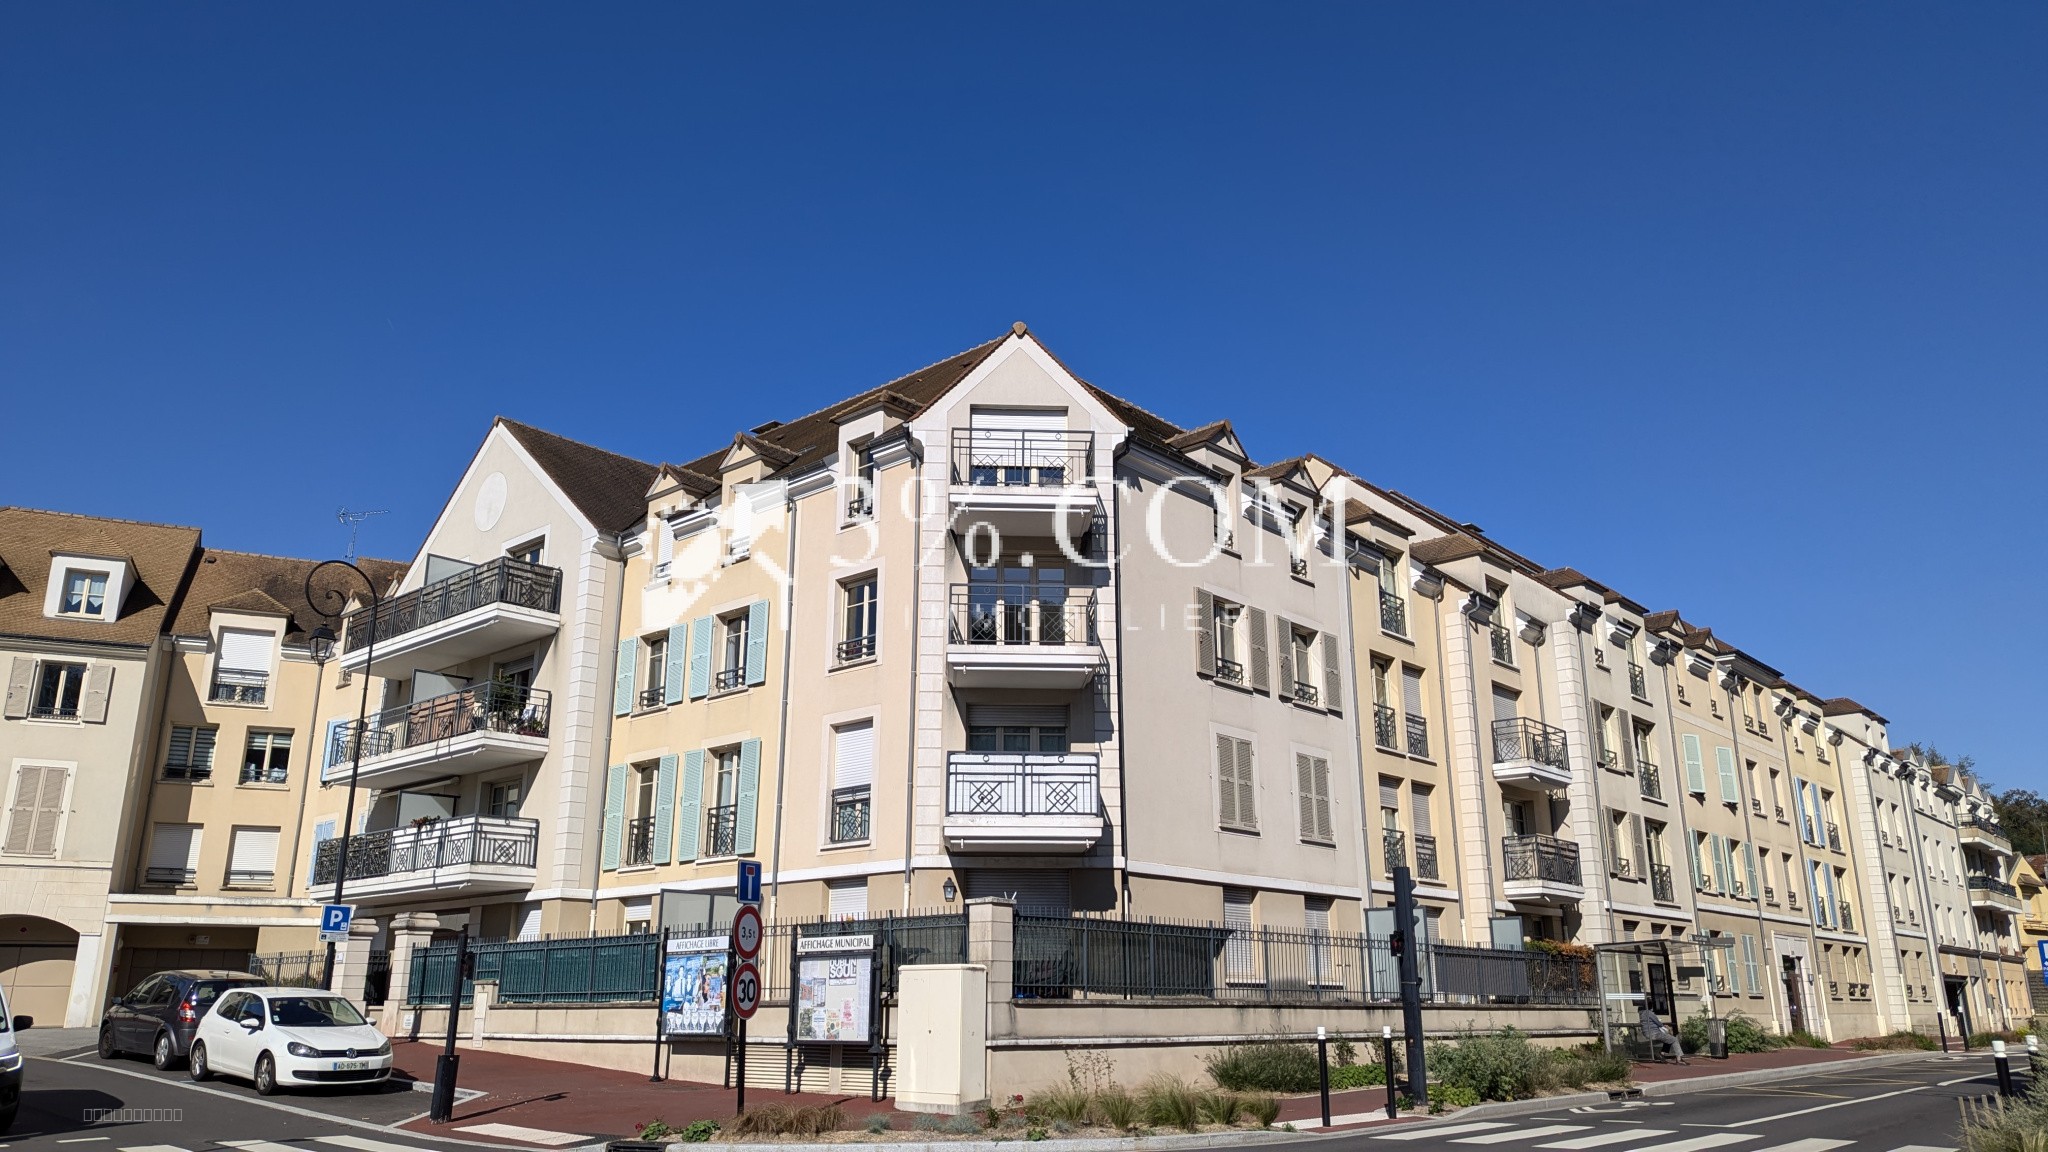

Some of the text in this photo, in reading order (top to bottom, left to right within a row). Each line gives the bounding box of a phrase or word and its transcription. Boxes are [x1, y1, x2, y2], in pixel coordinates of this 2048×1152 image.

[329, 910, 343, 927] P
[676, 939, 719, 950] AFFICHAGE LIBRE
[800, 937, 870, 950] AFFICHAGE MUNICIPAL
[829, 966, 857, 978] SOUL
[739, 978, 756, 1003] 30
